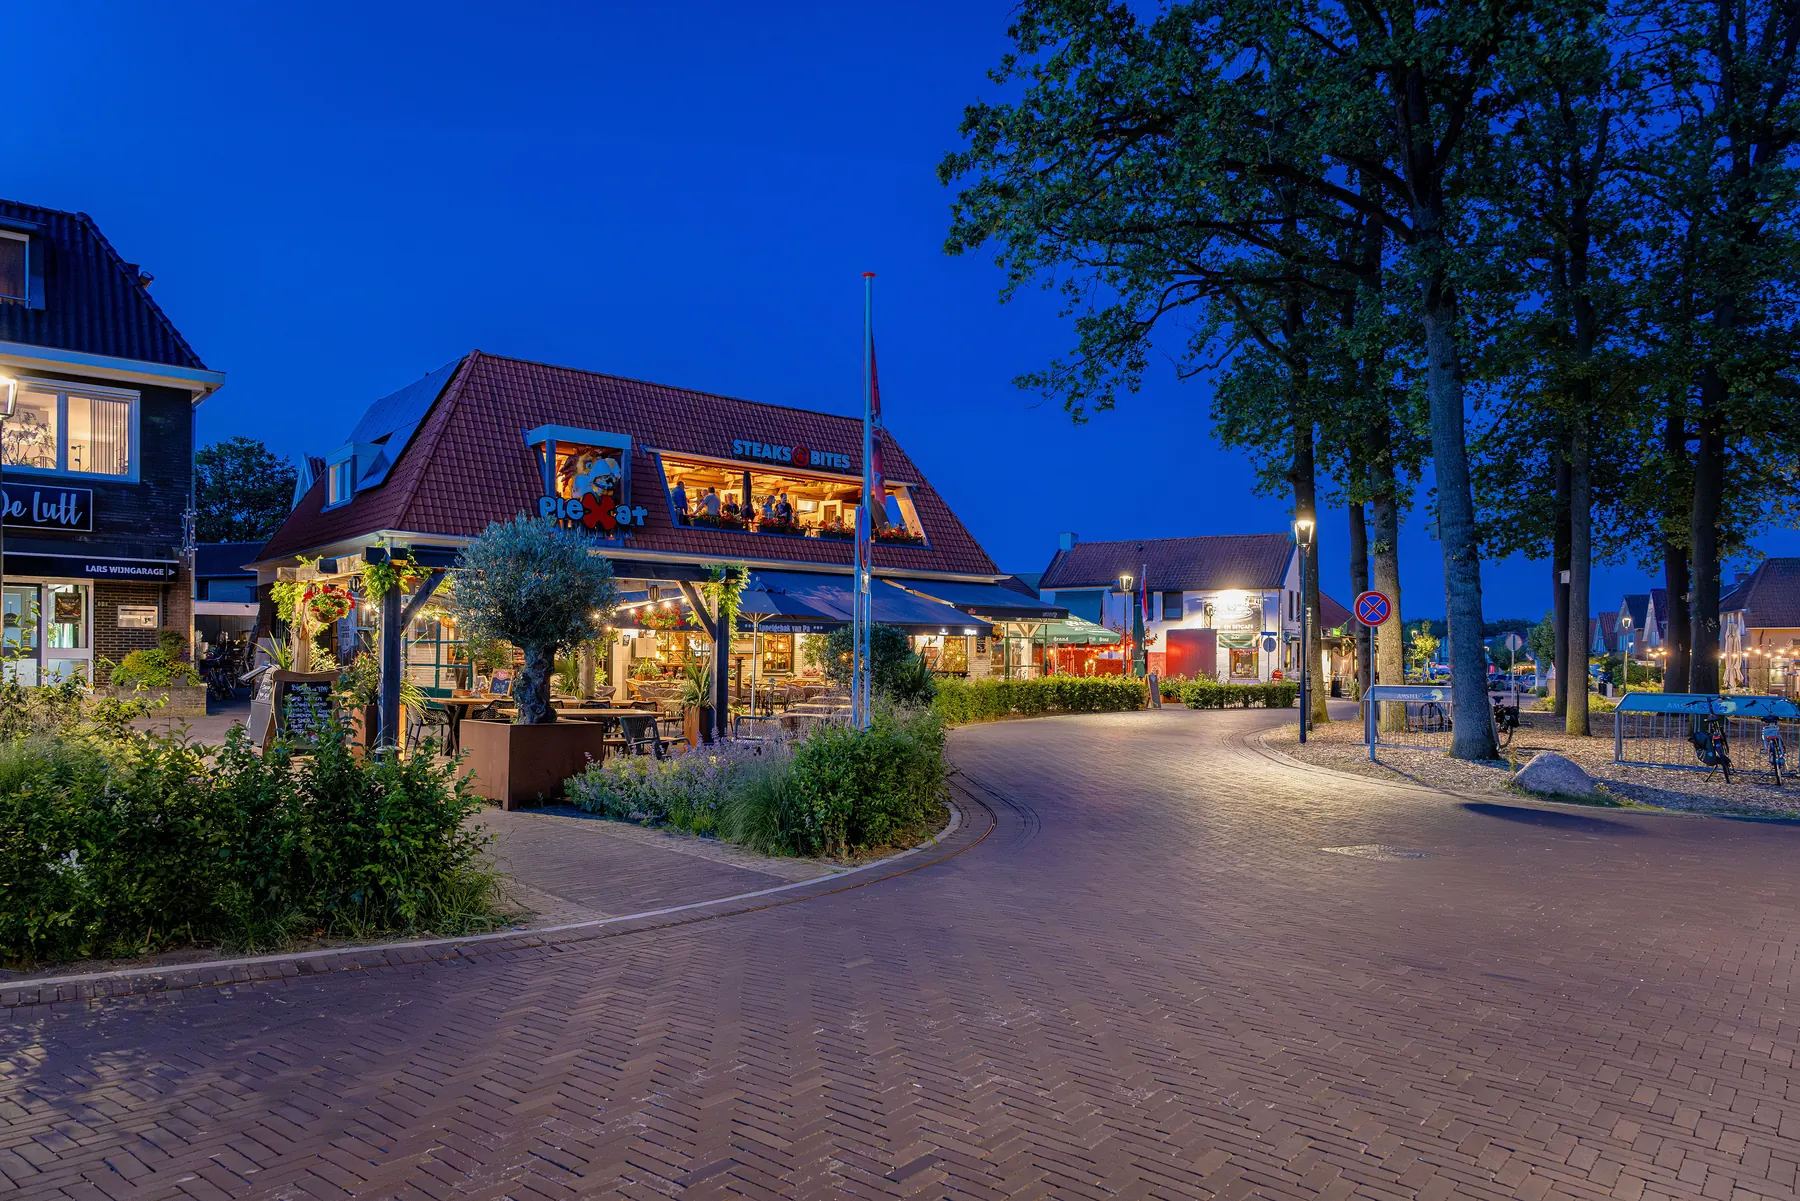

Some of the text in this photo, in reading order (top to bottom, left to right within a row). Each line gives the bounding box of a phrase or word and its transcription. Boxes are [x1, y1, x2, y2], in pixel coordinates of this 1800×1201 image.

[733, 440, 851, 469] STEAKS BITES
[33, 491, 82, 525] Lutt
[86, 564, 165, 576] LARS WIJNGARAGE
